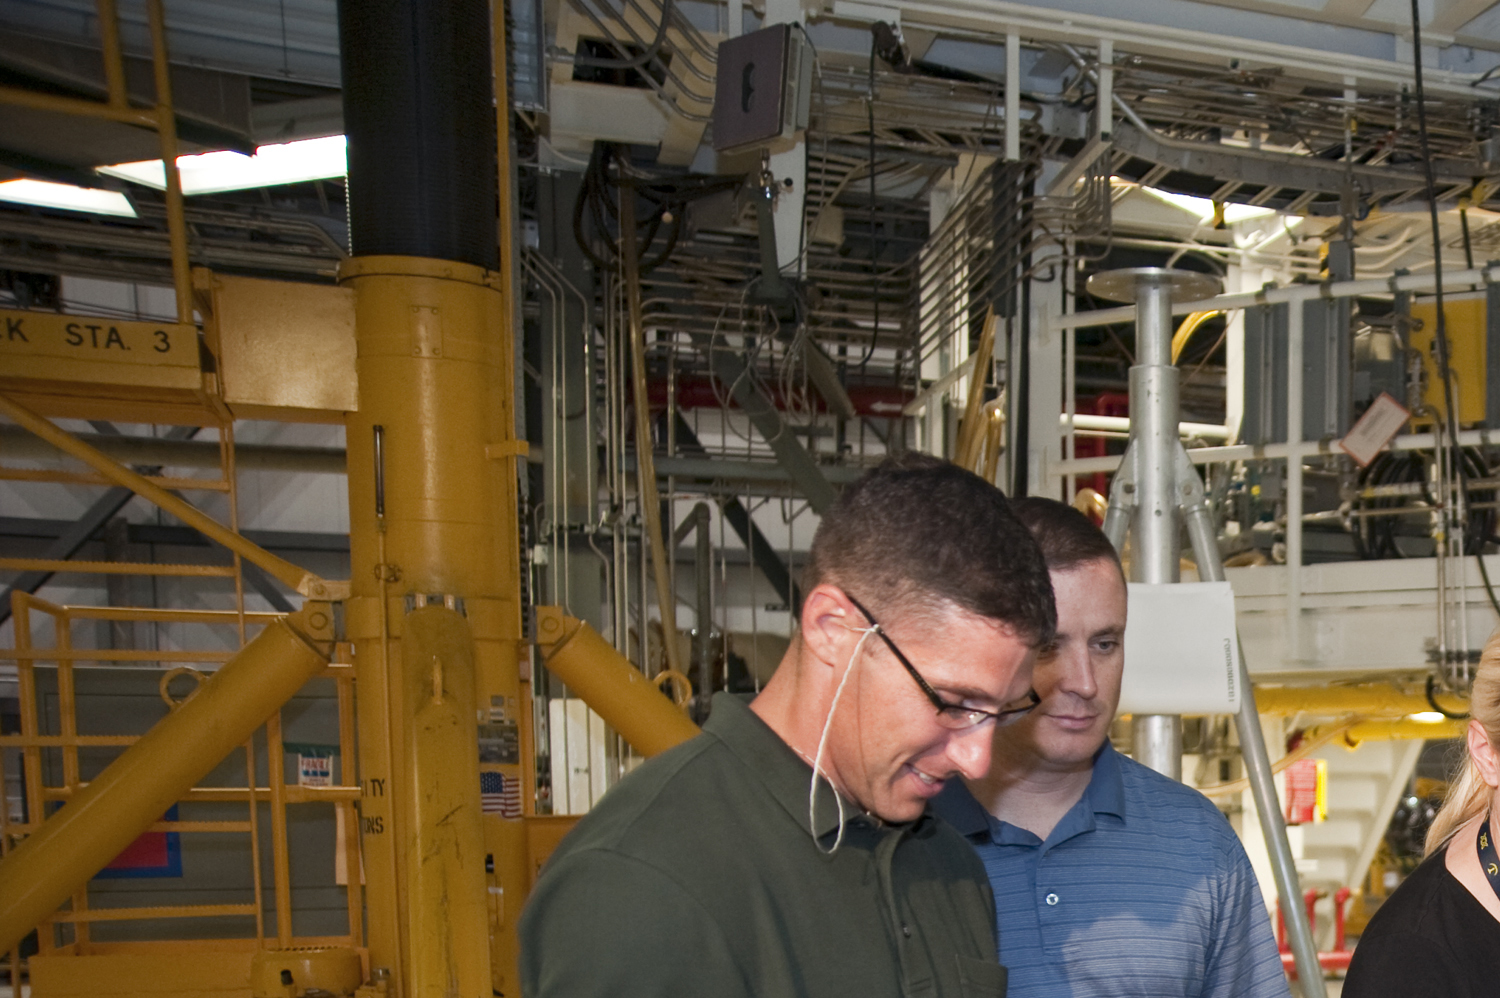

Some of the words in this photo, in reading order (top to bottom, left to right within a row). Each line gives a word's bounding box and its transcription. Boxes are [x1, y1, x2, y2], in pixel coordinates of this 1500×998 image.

[0, 317, 29, 343] K
[65, 323, 132, 351] STA.
[153, 330, 171, 353] 3
